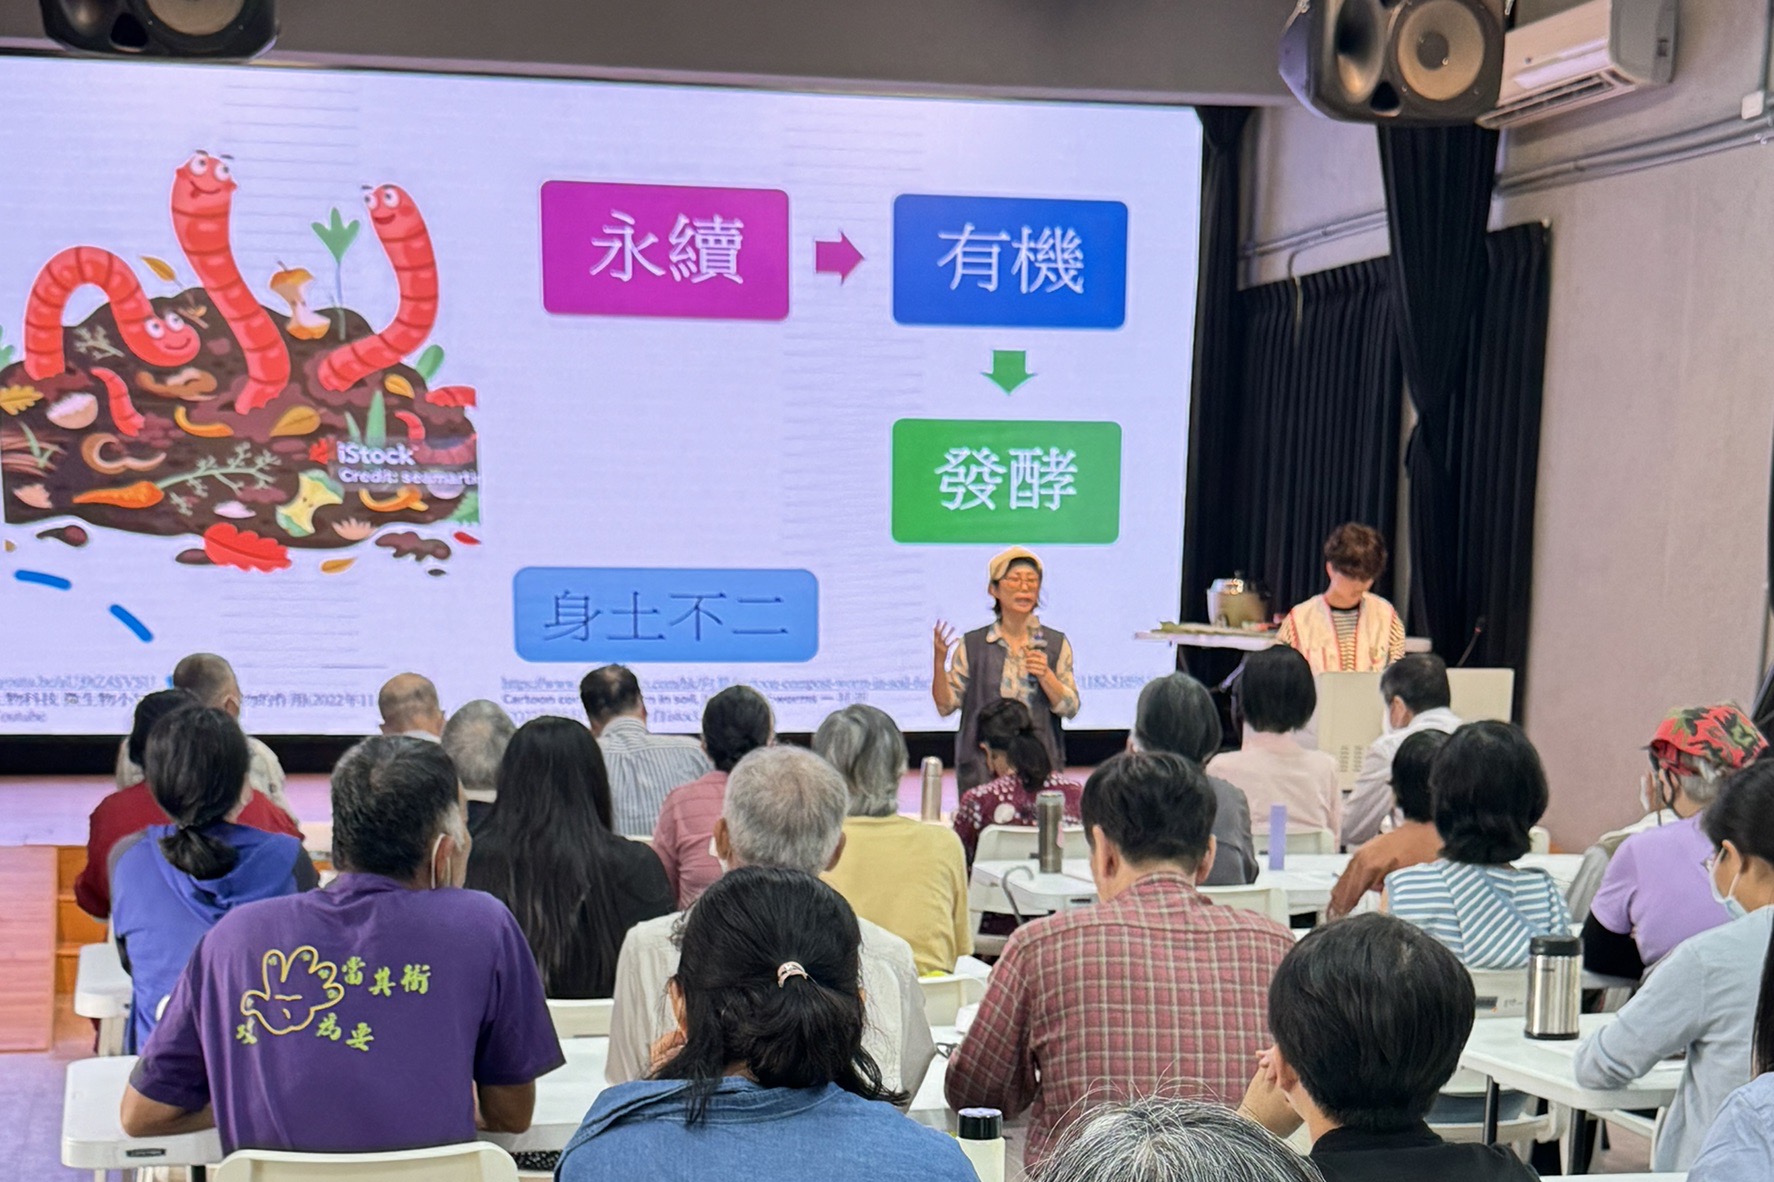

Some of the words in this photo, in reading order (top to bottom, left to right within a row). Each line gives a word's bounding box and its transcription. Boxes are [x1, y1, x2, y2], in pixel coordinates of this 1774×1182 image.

[589, 209, 744, 286] 永續
[936, 221, 1086, 294] 有機
[336, 440, 416, 466] iStock
[933, 446, 1079, 512] 發酵
[543, 589, 790, 645] 身土不二
[503, 694, 555, 705] Cartoon
